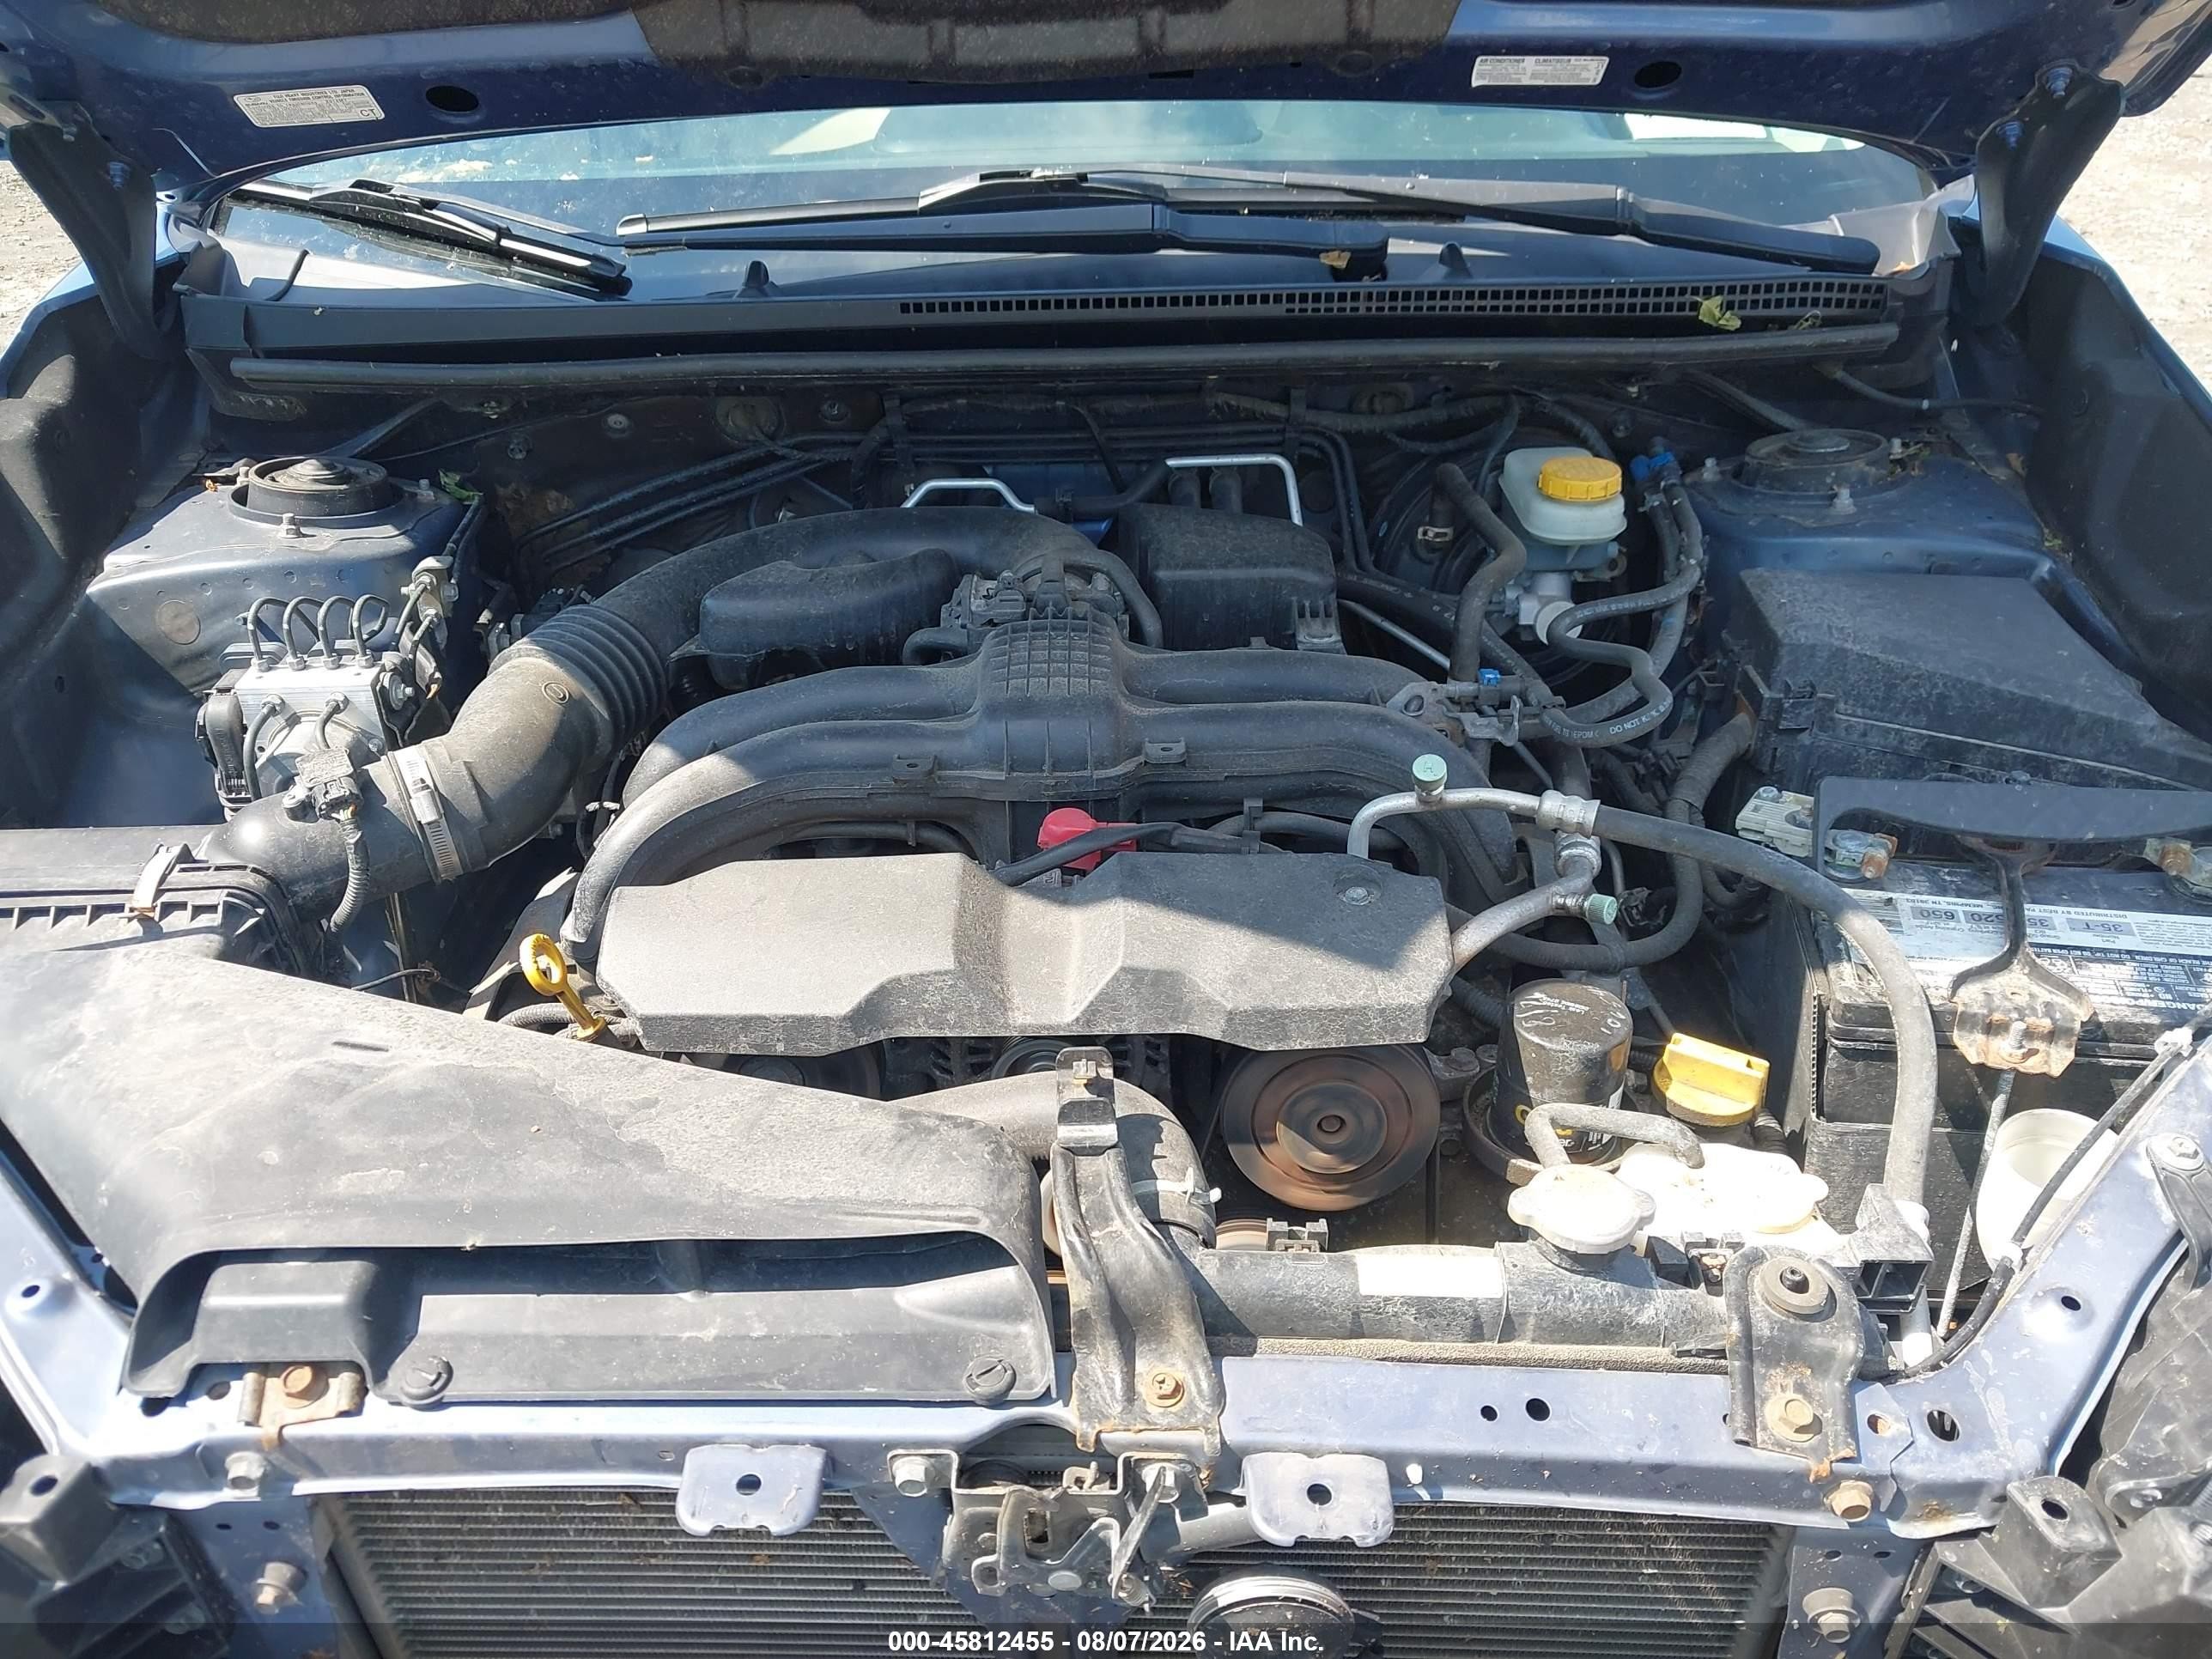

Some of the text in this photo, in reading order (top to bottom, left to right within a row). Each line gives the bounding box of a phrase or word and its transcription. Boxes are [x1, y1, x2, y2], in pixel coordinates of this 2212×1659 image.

[360, 108, 376, 118] CT
[1609, 725, 1623, 735] DO
[1920, 909, 1955, 920] 650
[2027, 918, 2049, 927] 35
[2082, 921, 2124, 933] 35-T
